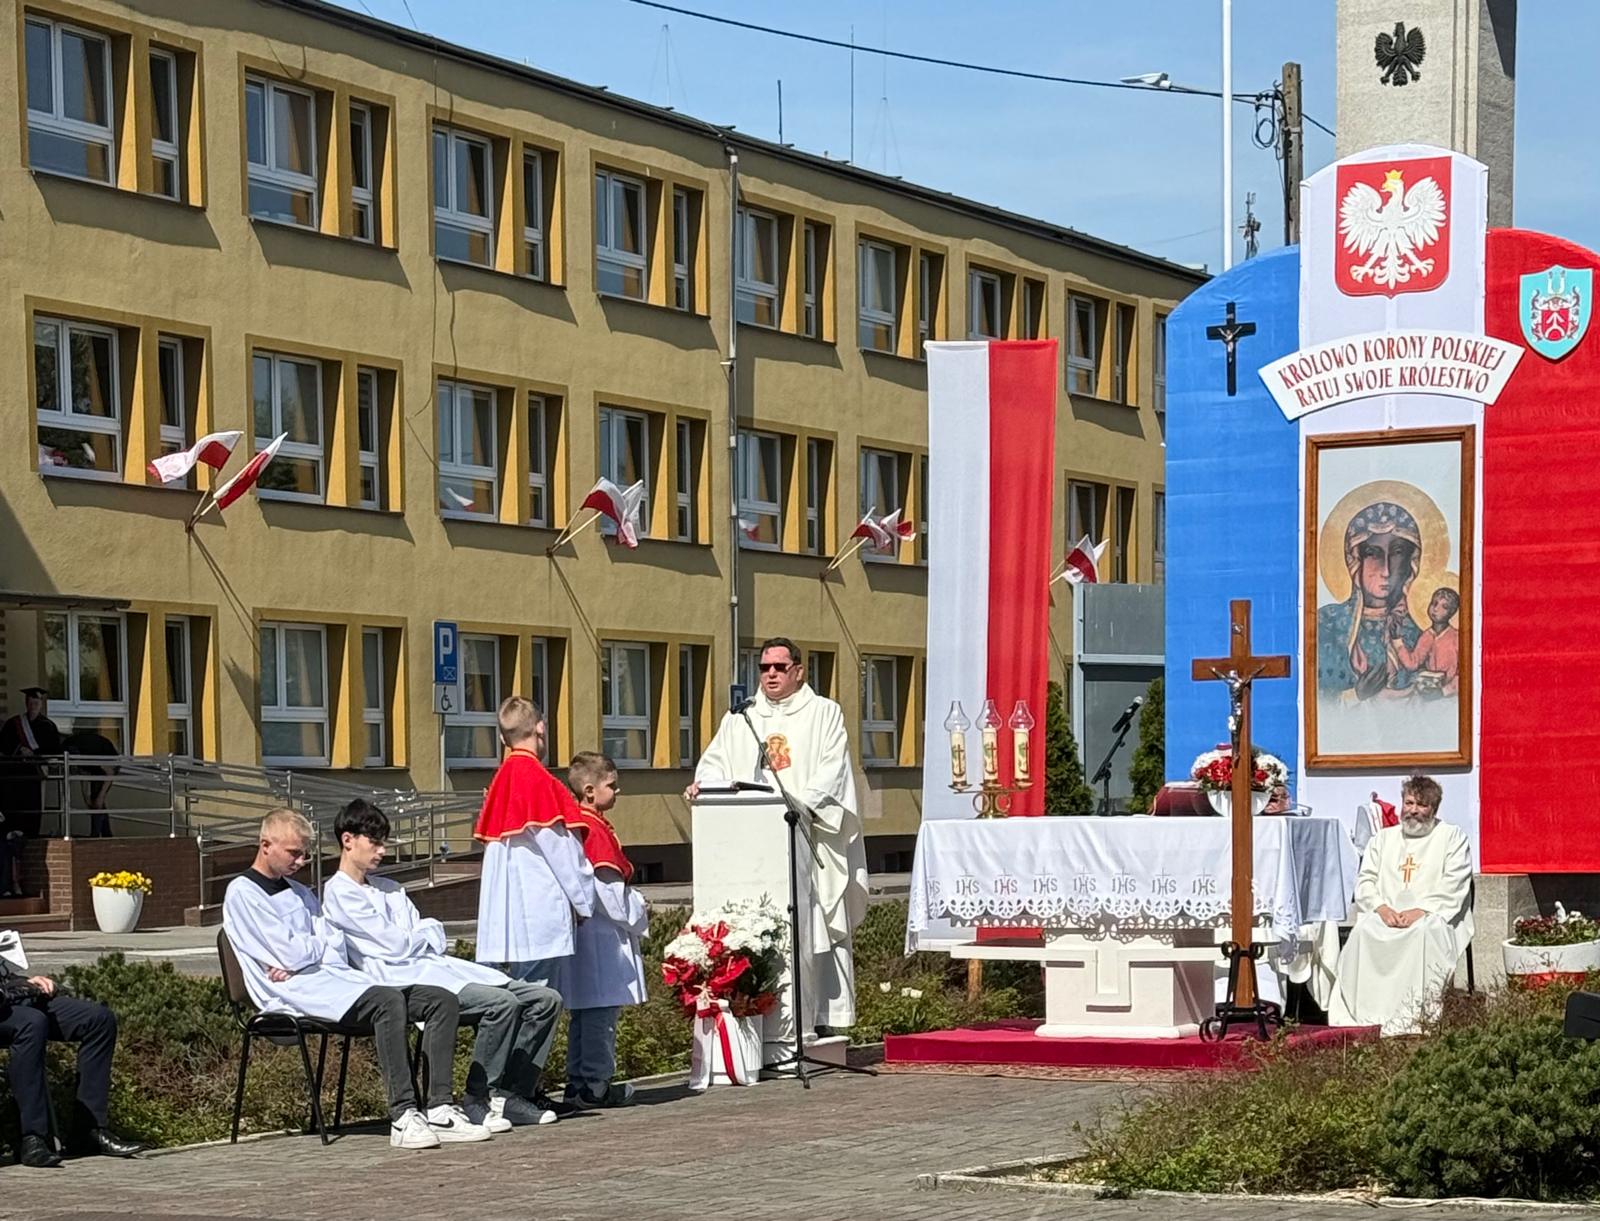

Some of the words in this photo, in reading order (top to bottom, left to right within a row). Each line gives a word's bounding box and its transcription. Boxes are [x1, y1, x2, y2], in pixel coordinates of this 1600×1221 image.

[1278, 343, 1358, 389] KRÓLOWO
[1363, 335, 1428, 362] KORONY
[1430, 336, 1507, 371] POLSKIEJ
[1294, 377, 1340, 408] RATUJ
[1344, 367, 1393, 394] SWOJE
[1398, 361, 1490, 393] KRÓLESTWO
[439, 627, 453, 665] P
[955, 879, 980, 895] IHS
[993, 879, 1018, 895] IHS
[1033, 878, 1058, 894] IHS
[1073, 877, 1097, 894] IHS
[1111, 877, 1137, 894] IHS
[1151, 878, 1177, 895] IHS
[1191, 878, 1216, 895] IHS
